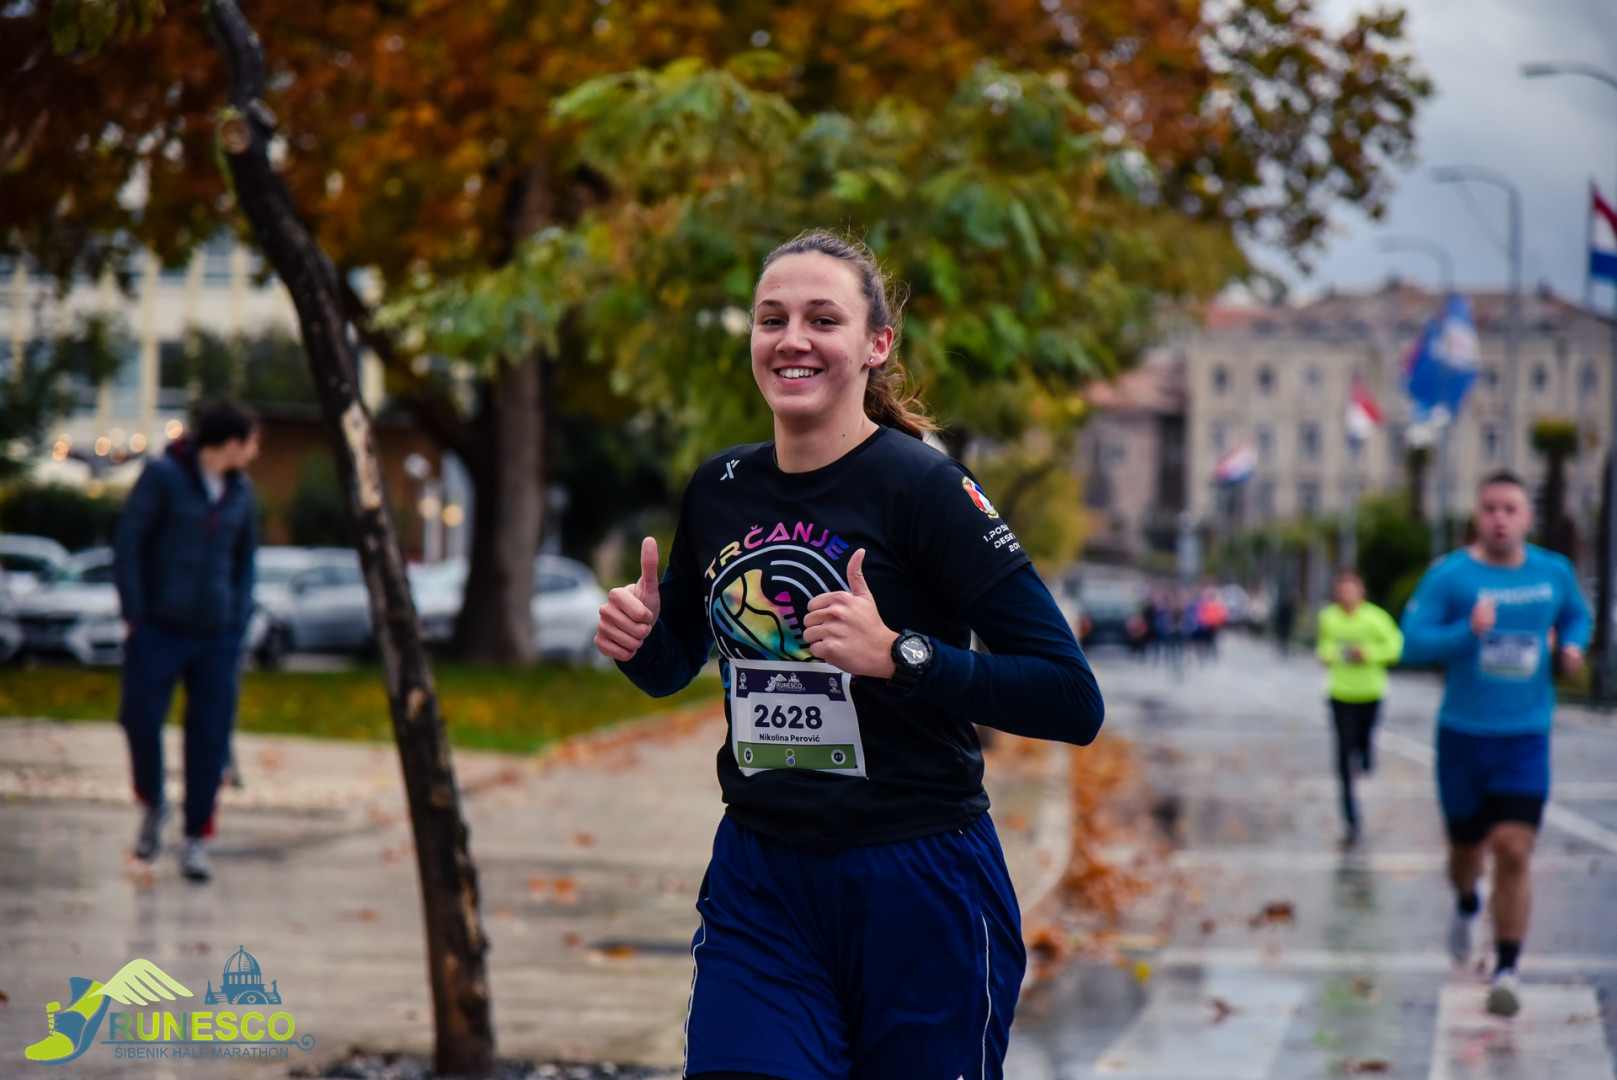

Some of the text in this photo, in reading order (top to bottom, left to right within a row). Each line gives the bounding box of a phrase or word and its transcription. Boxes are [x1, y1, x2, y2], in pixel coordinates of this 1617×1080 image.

[704, 521, 850, 580] TRČANJE
[754, 703, 823, 730] 2628
[759, 733, 820, 743] Nikolina Perović
